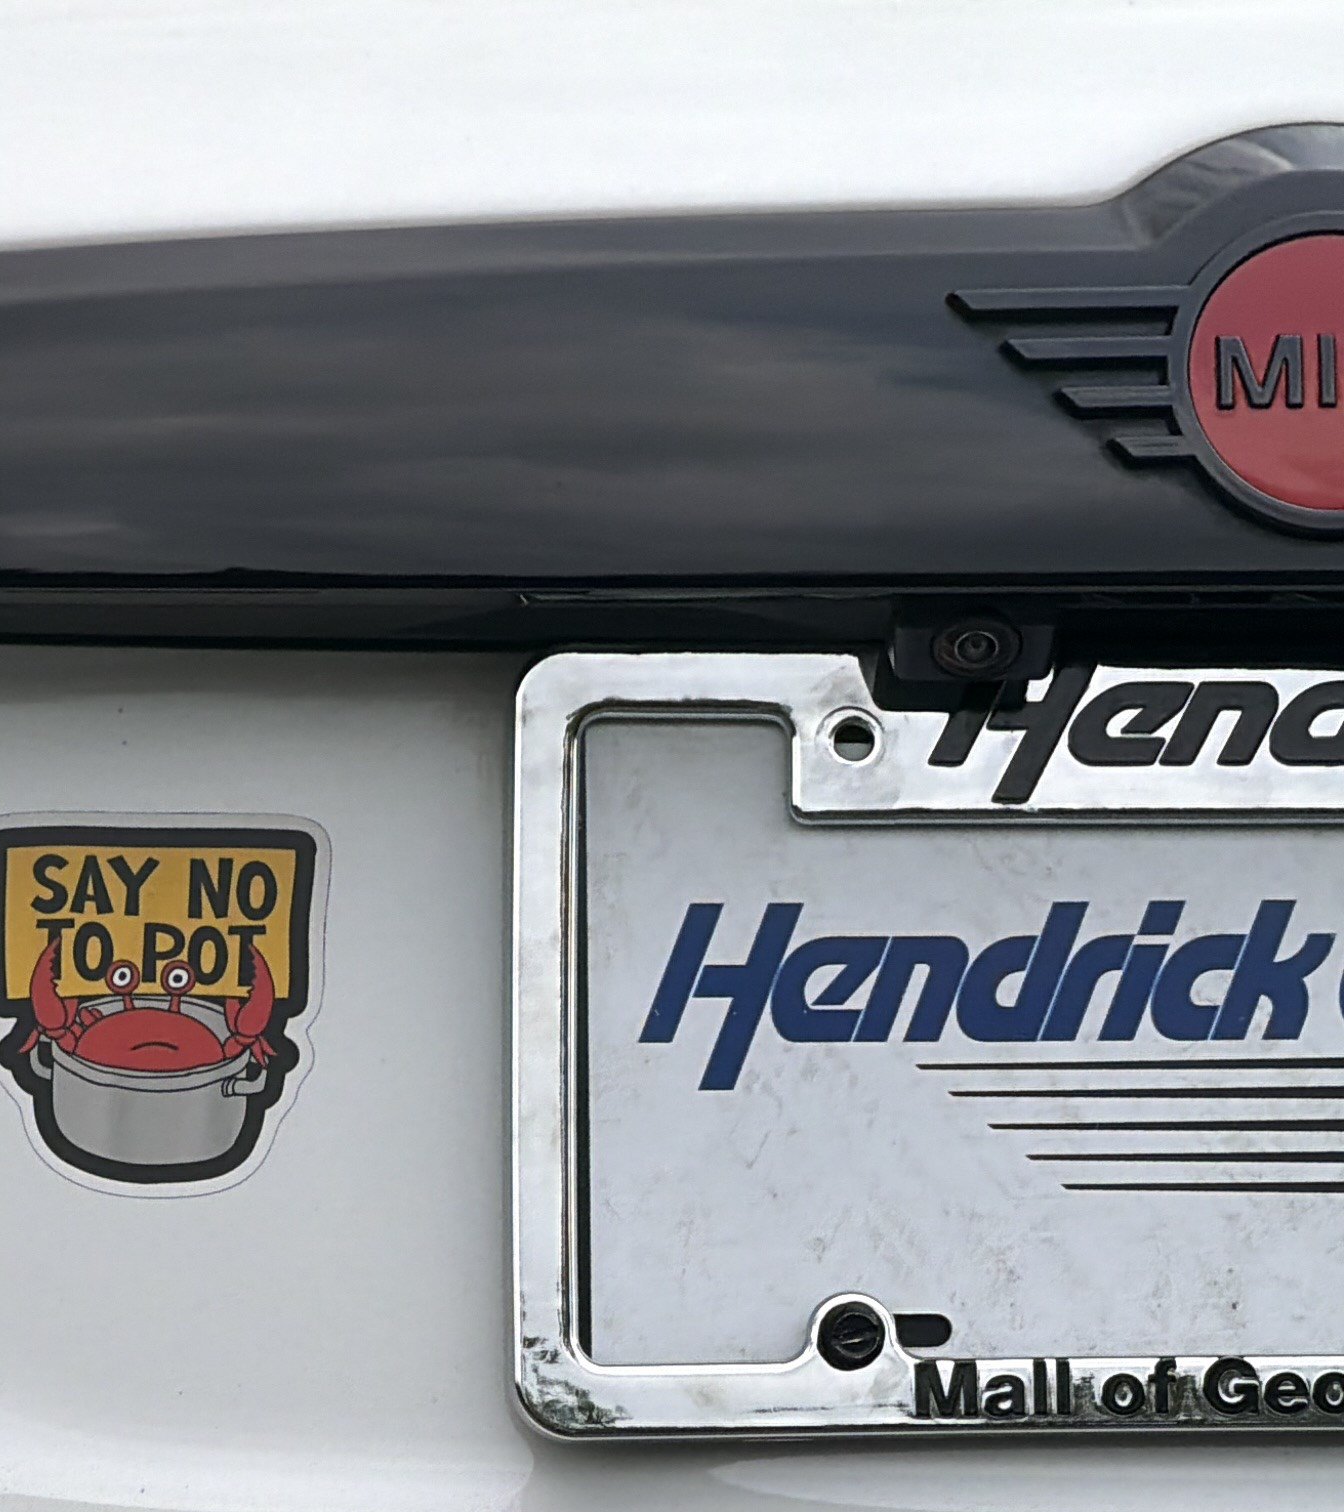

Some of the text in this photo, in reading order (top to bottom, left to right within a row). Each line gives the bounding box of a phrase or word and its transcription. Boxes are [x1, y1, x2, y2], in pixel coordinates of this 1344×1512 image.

[1216, 333, 1337, 410] MI
[30, 853, 278, 920] SAY NO
[35, 918, 267, 987] TO POT
[638, 899, 1337, 1091] Hendrick
[914, 1357, 1071, 1418] Mall
[1102, 1357, 1176, 1416] of
